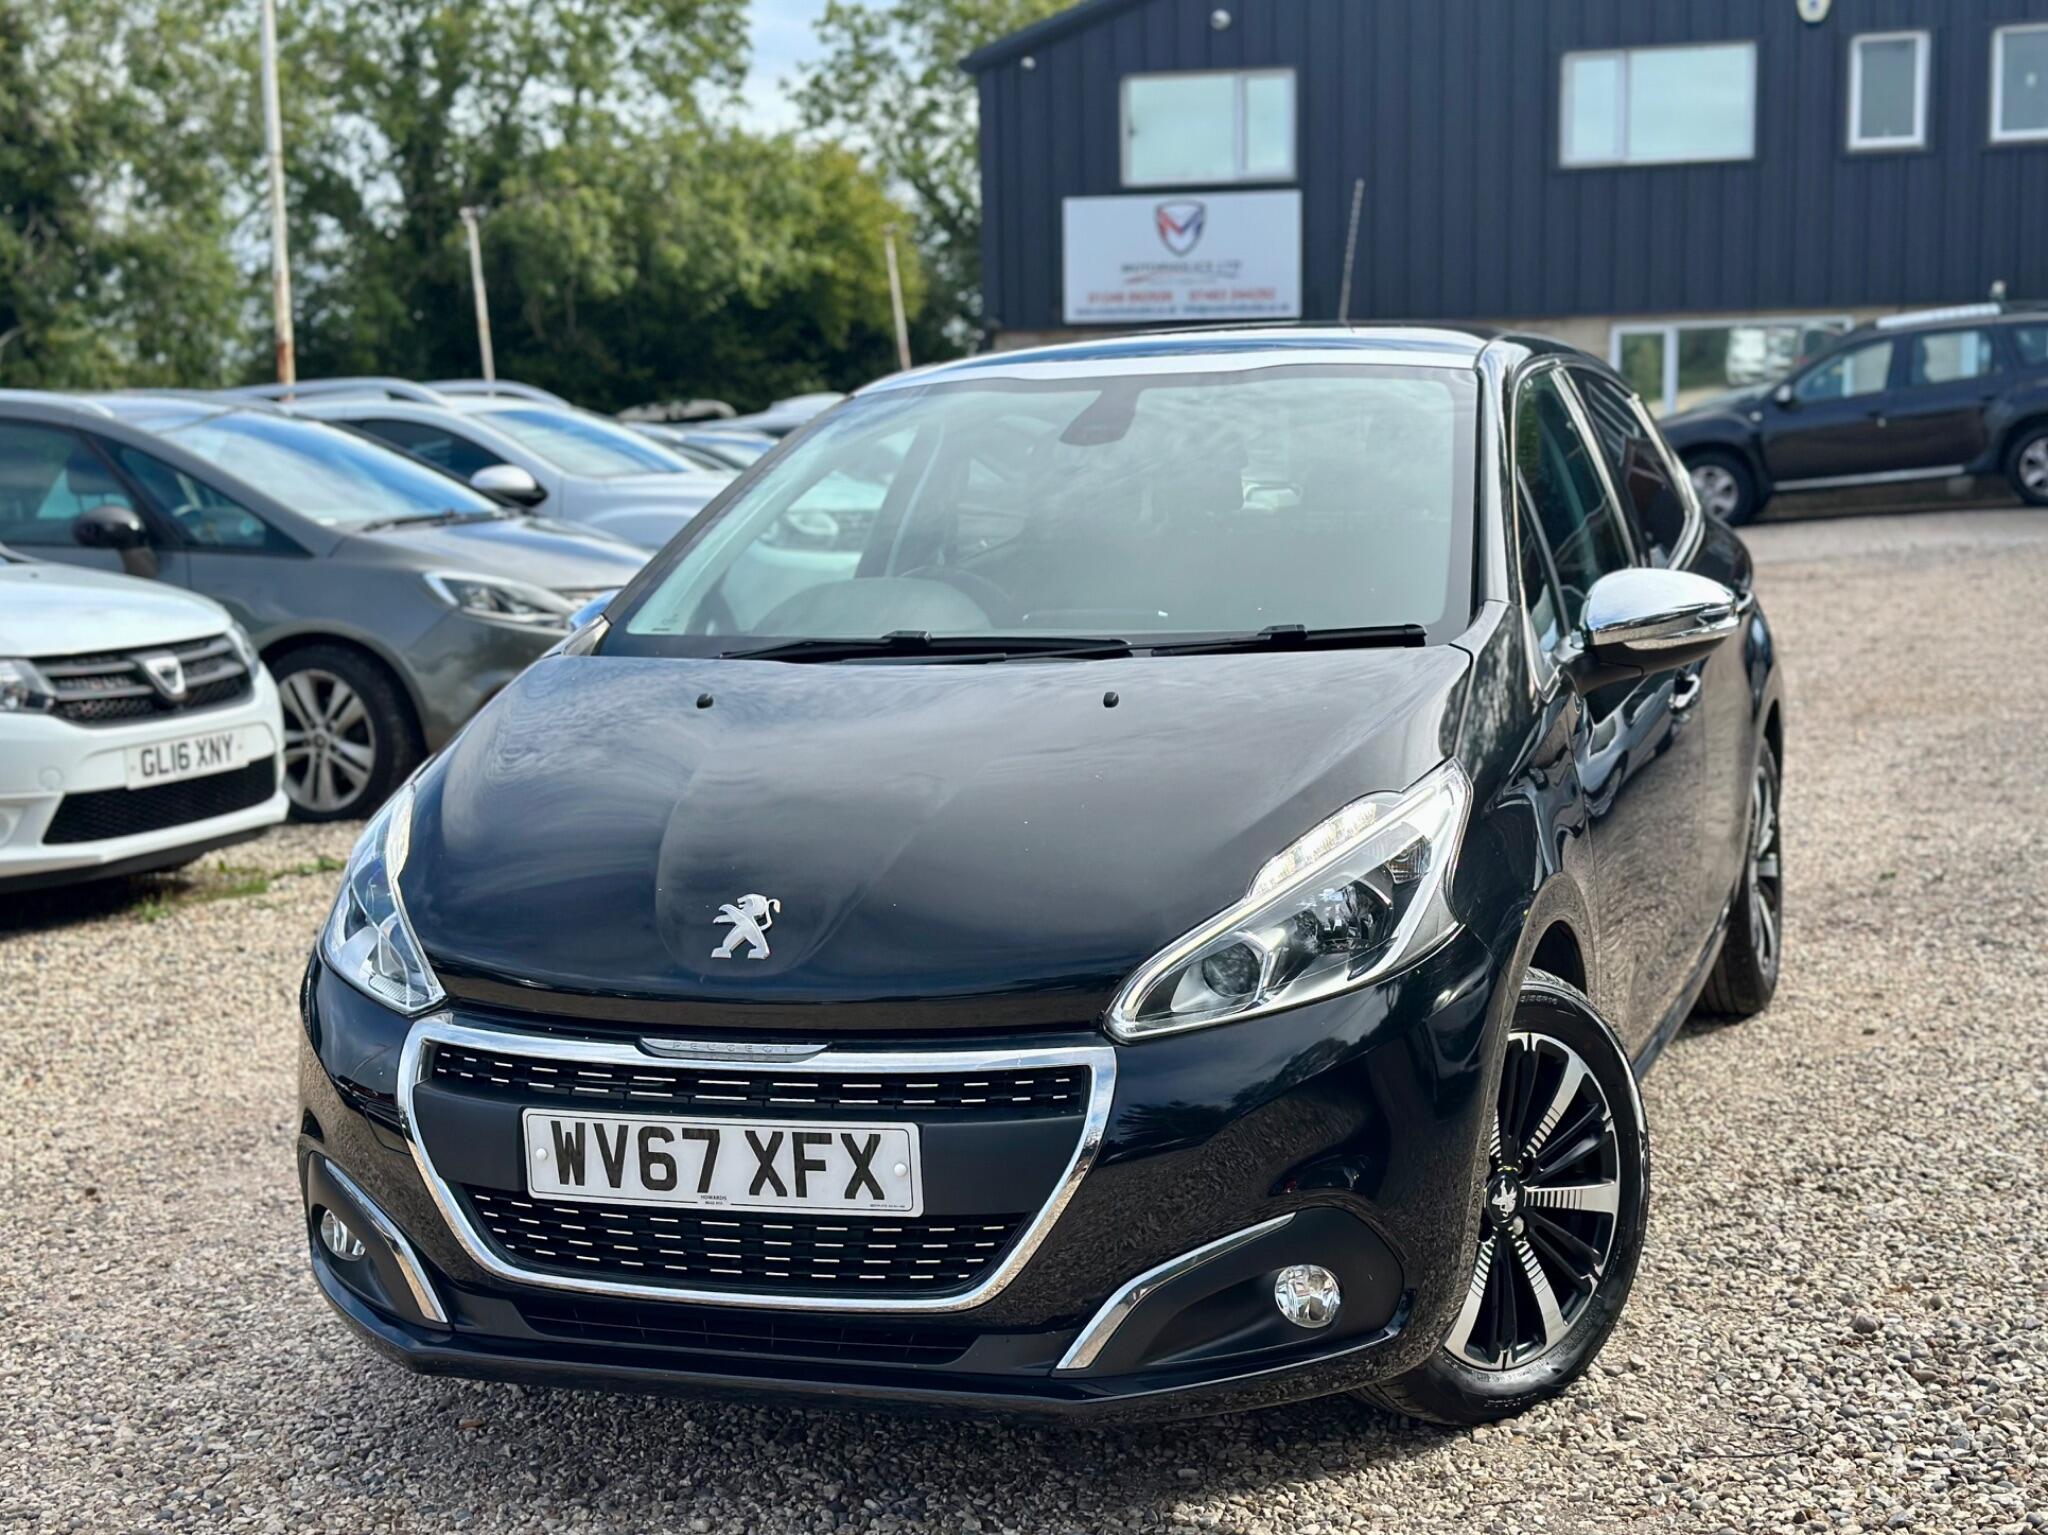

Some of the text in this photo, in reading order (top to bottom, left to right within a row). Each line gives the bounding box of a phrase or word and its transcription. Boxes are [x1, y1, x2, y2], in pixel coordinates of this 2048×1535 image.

[141, 733, 233, 777] GL16 XNY
[672, 1042, 792, 1054] PEUGEOT
[550, 1120, 885, 1201] WV67 XFX
